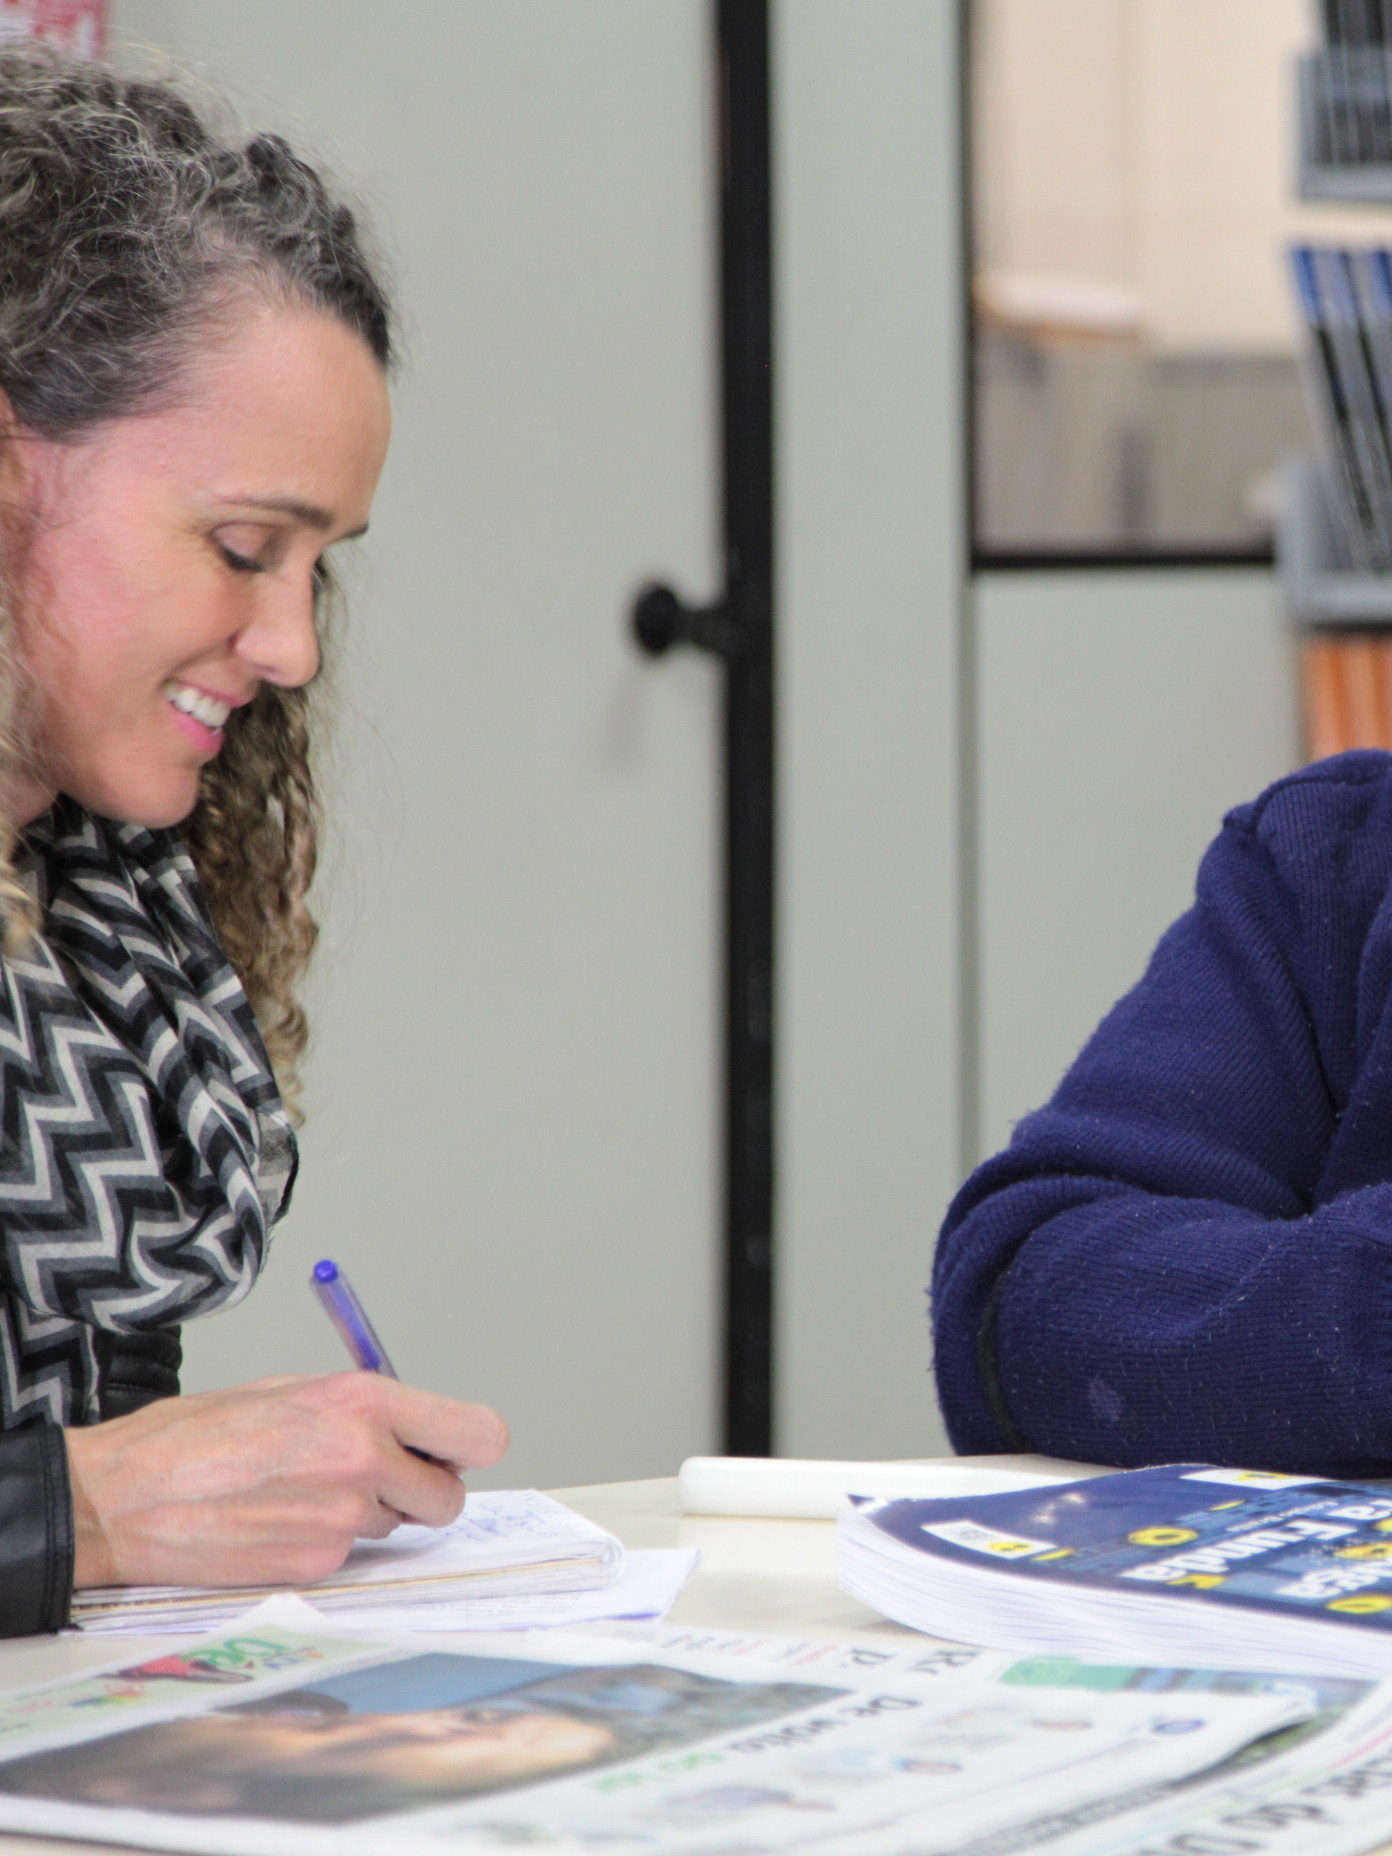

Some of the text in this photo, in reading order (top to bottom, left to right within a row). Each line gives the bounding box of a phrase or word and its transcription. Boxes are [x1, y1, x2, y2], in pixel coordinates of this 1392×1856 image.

[1117, 1519, 1358, 1582] Funda
[840, 1695, 923, 1718] De
[1219, 1802, 1338, 1830] do
